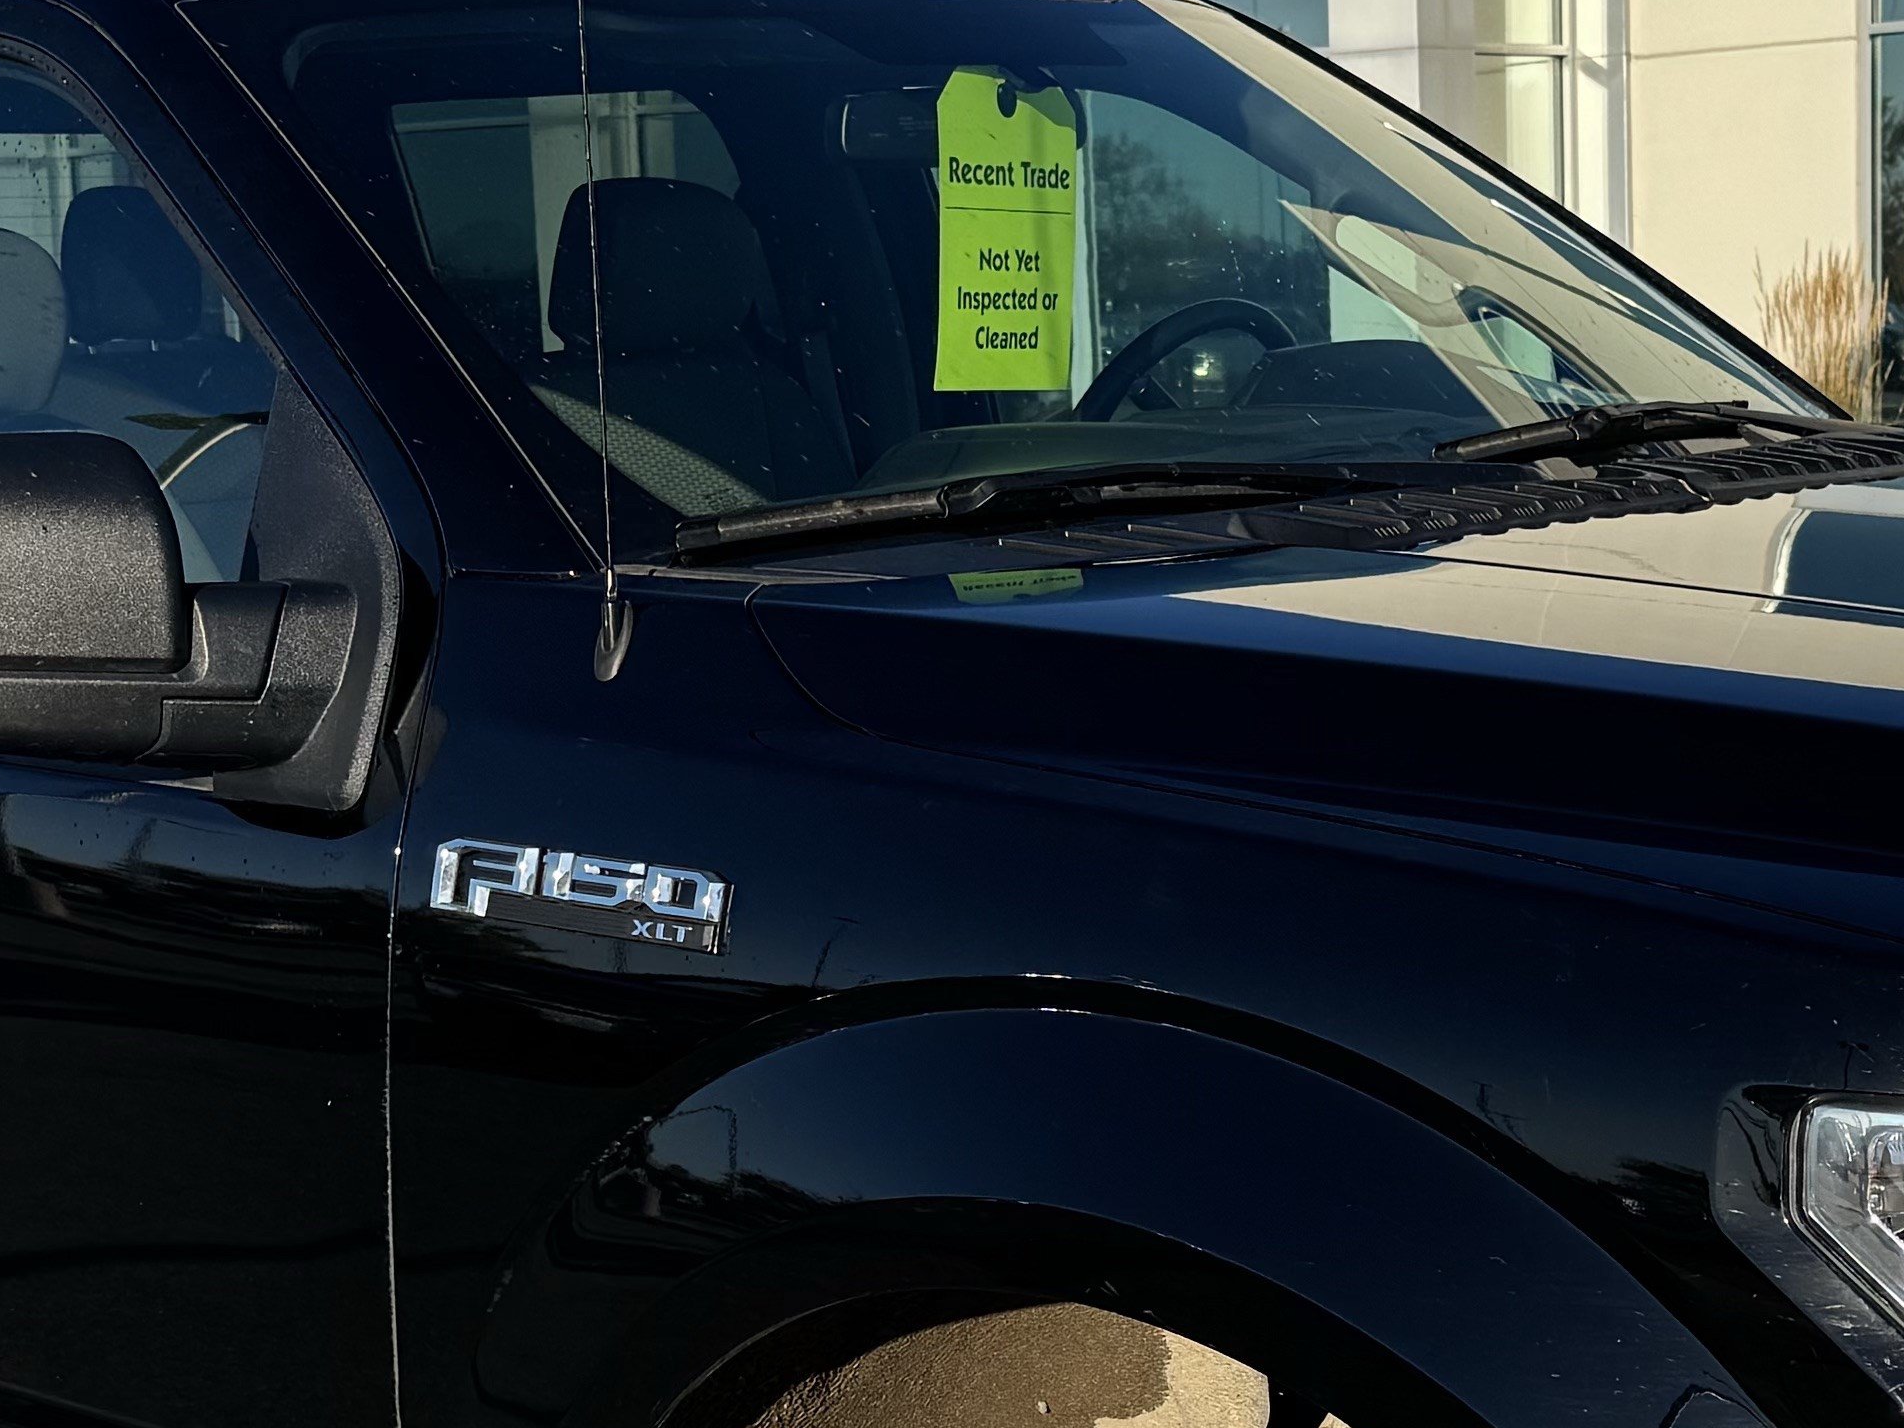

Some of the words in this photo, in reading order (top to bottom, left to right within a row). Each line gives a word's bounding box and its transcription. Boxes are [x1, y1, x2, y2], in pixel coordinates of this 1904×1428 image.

[948, 156, 1015, 187] Recent
[1020, 160, 1070, 190] Trade
[979, 248, 1009, 272] Not
[1014, 250, 1040, 272] Yet
[956, 286, 1037, 315] Inspected
[1042, 293, 1058, 310] or
[975, 326, 1039, 350] Cleaned
[631, 919, 693, 943] XLT
